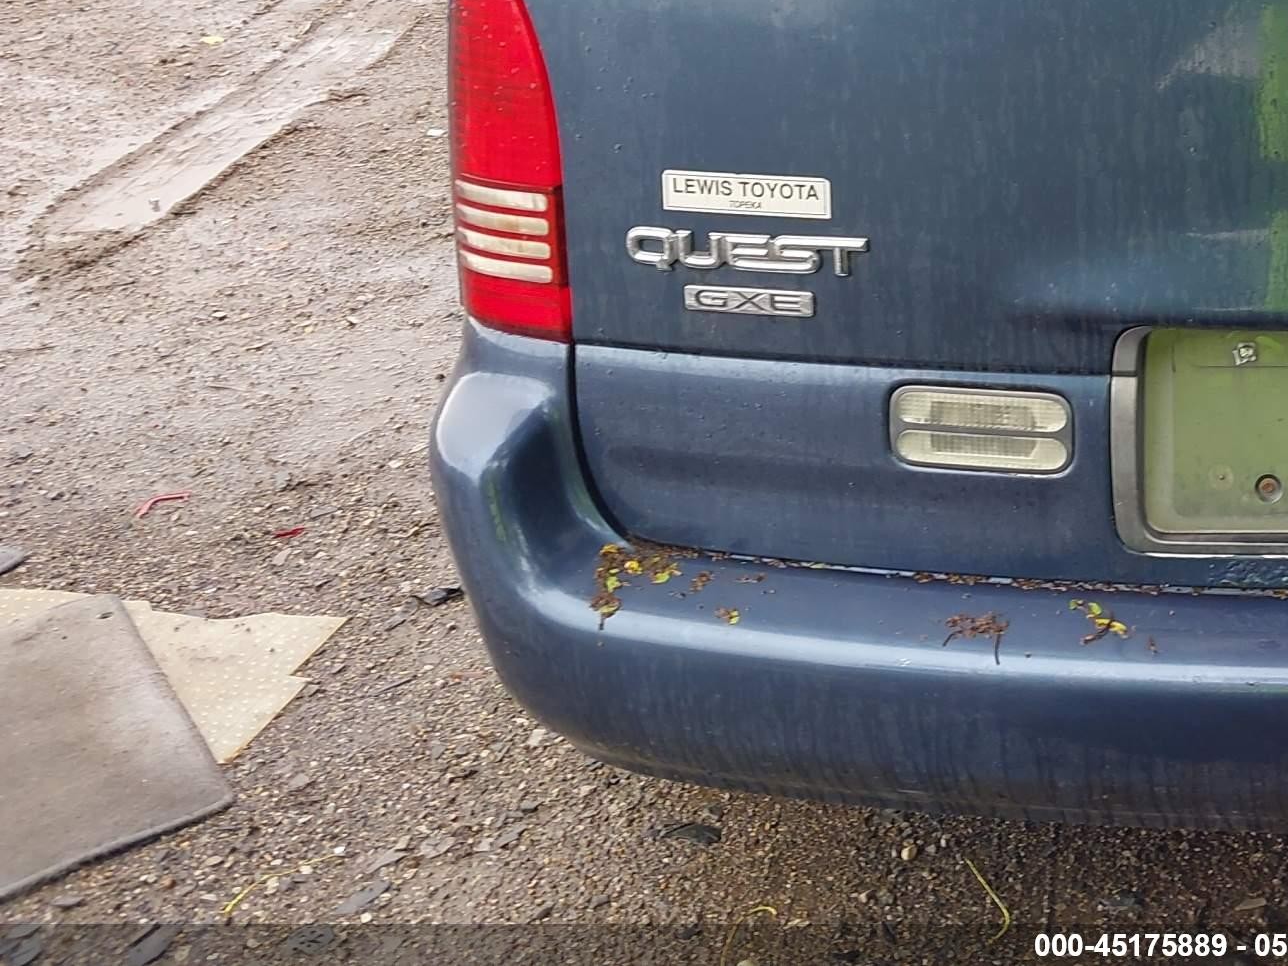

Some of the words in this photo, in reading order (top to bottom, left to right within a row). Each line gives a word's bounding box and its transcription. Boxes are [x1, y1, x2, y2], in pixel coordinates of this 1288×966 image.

[672, 177, 733, 197] LEWIS
[736, 181, 820, 201] TOYOTA
[625, 225, 869, 277] QUEST
[695, 288, 802, 312] GXE
